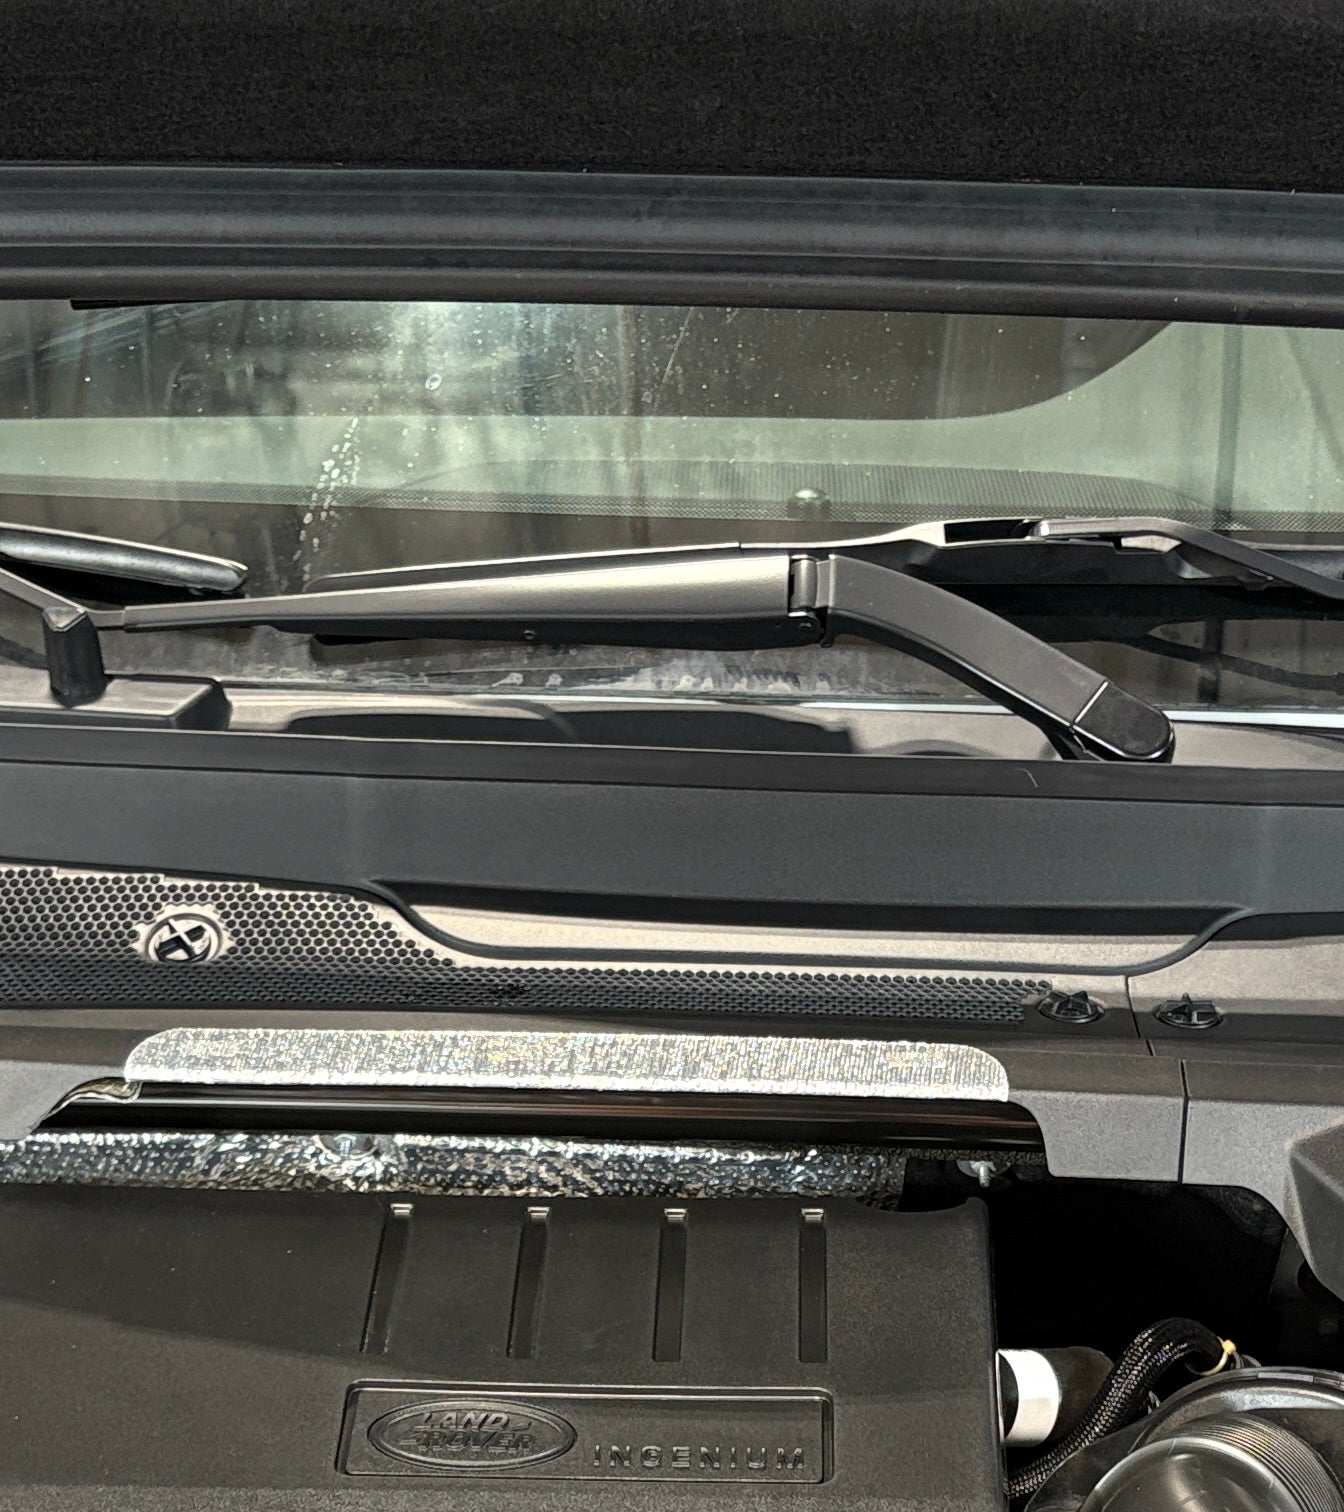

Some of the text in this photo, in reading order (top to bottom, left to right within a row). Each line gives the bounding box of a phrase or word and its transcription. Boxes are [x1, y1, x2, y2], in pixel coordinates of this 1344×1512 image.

[414, 1411, 512, 1431] LAND
[416, 1430, 537, 1454] ROVER
[592, 1444, 805, 1471] INGENIUM
